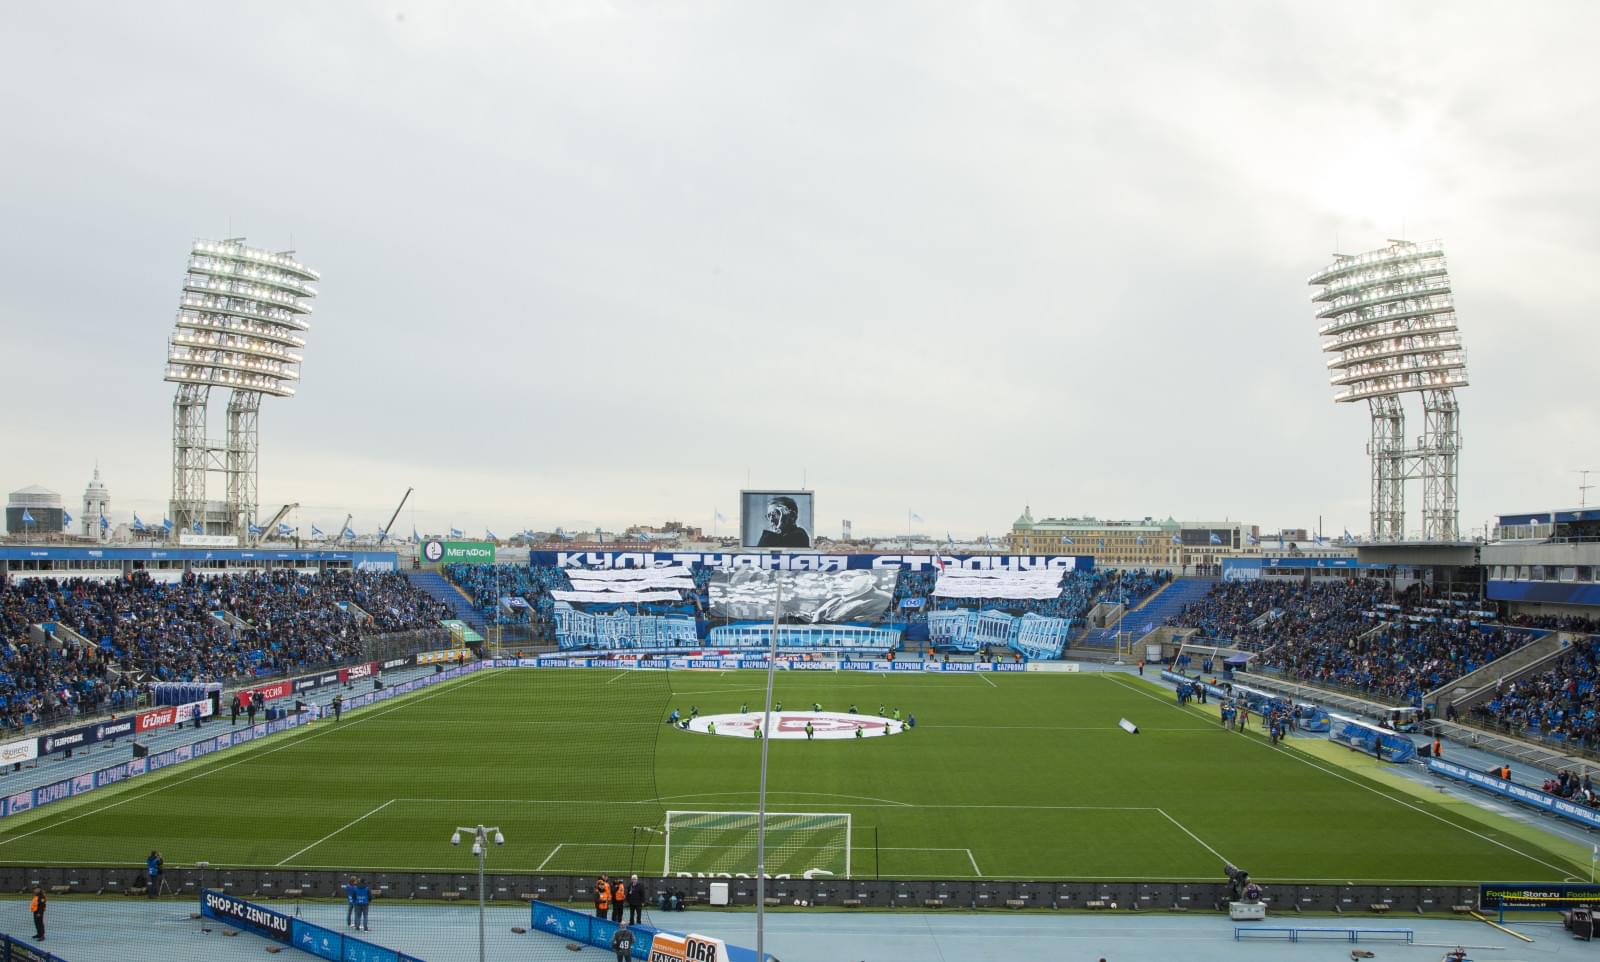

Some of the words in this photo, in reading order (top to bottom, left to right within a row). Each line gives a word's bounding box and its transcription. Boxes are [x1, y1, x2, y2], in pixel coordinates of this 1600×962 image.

[691, 660, 717, 669] GAZPROM
[742, 661, 769, 669] GAZPROM
[843, 661, 869, 670] GAZPROM
[894, 661, 921, 670] GAZPROM
[945, 662, 971, 671] GAZPROM
[997, 662, 1022, 671] GAZPROM
[618, 940, 629, 950] 49
[686, 939, 716, 962] 068
